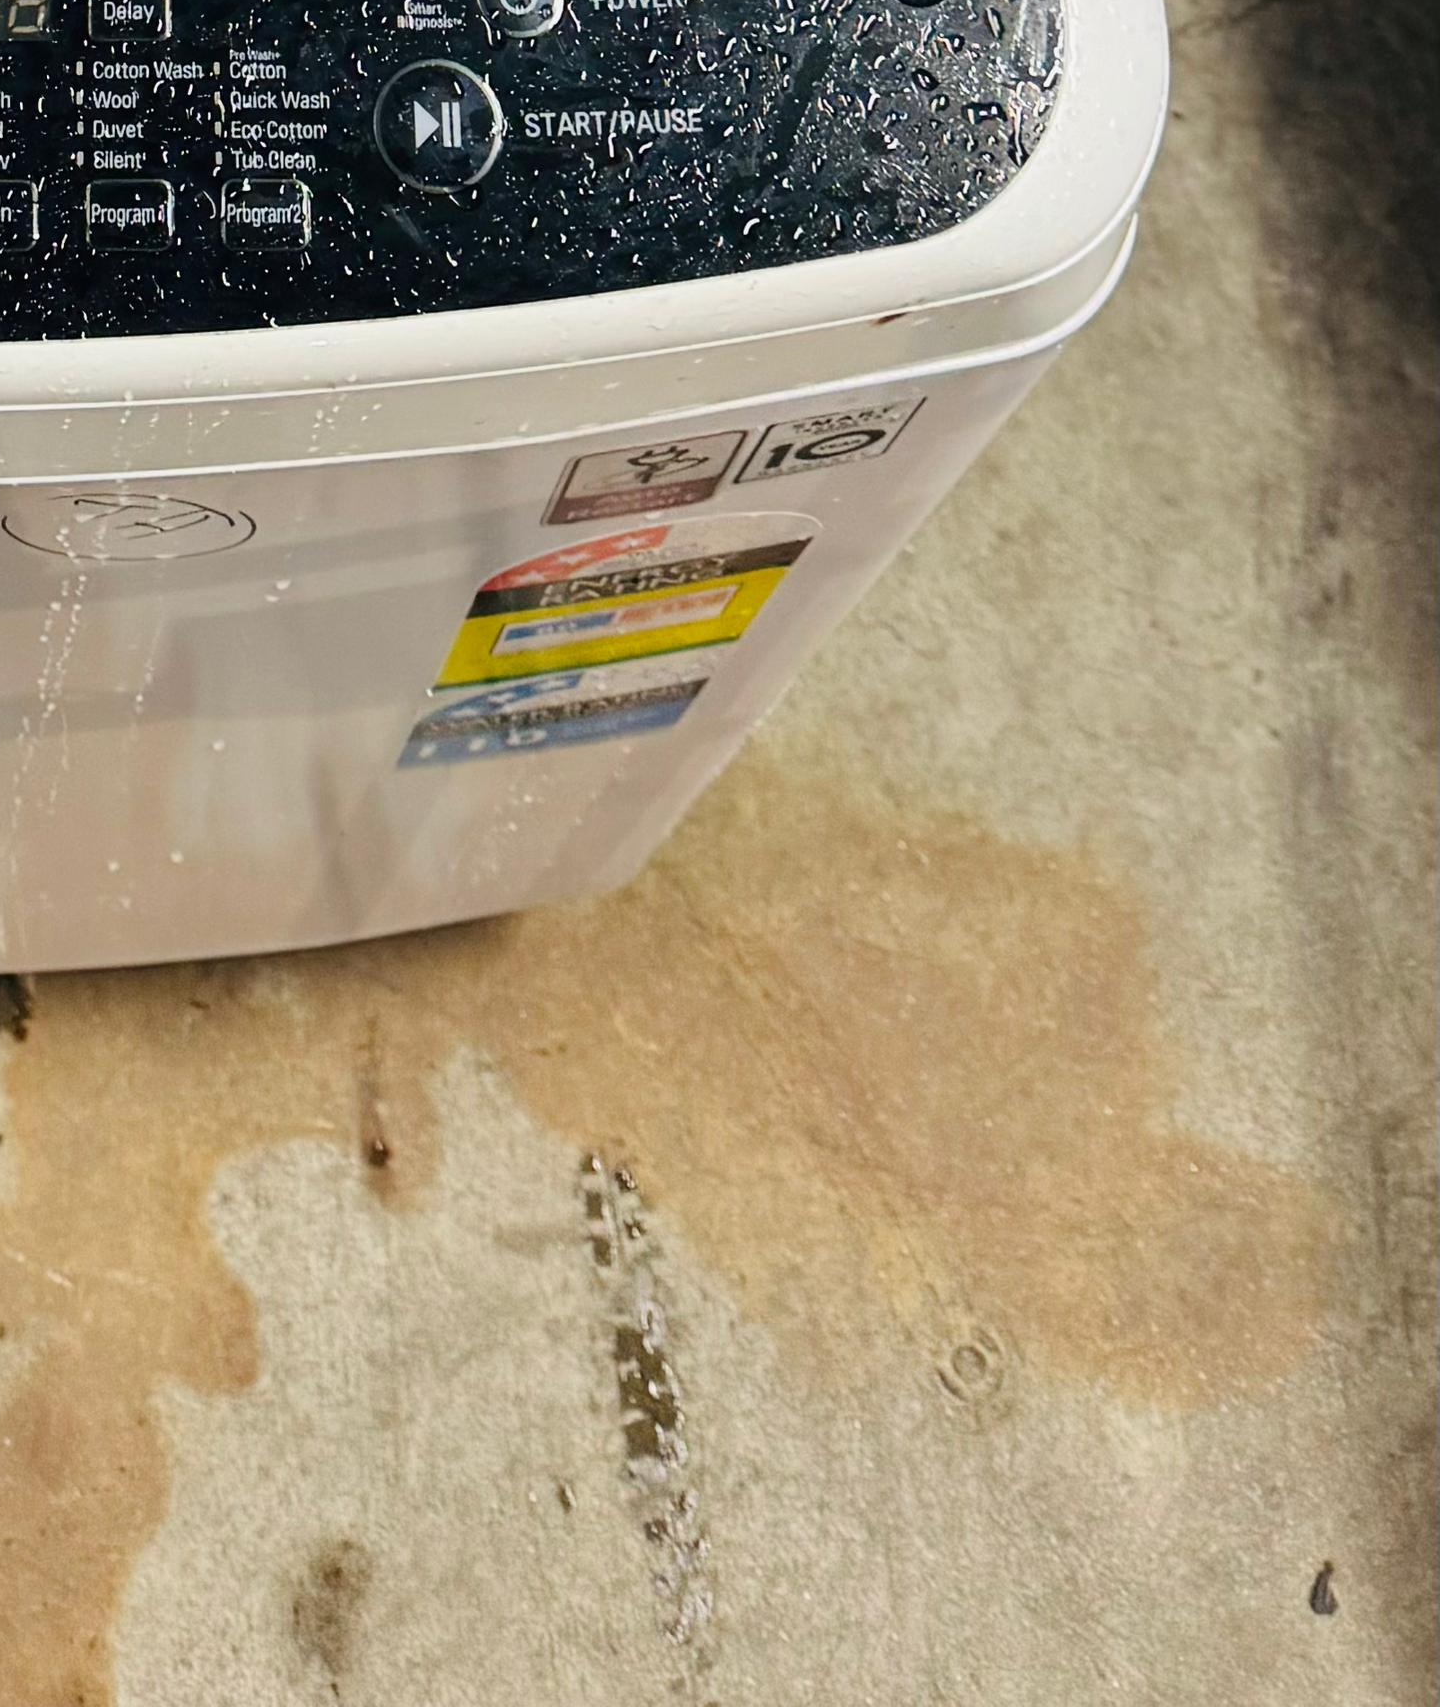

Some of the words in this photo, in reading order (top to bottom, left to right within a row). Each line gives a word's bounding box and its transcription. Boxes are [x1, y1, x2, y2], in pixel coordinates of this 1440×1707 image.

[103, 0, 155, 24] Delay
[93, 61, 150, 79] Cotton
[154, 61, 203, 79] Wash
[229, 62, 287, 80] Cotton
[93, 91, 137, 109] Wool
[230, 91, 277, 111] Quick
[281, 91, 330, 109] Wash
[93, 120, 144, 139] Duvet
[231, 121, 262, 140] Eco
[267, 121, 323, 140] Cotton
[93, 150, 143, 169] Silent
[233, 150, 265, 169] Tub
[268, 150, 316, 170] Clean
[91, 203, 155, 228] Program
[227, 203, 289, 228] Program
[290, 204, 302, 223] 2
[766, 429, 886, 469] 10
